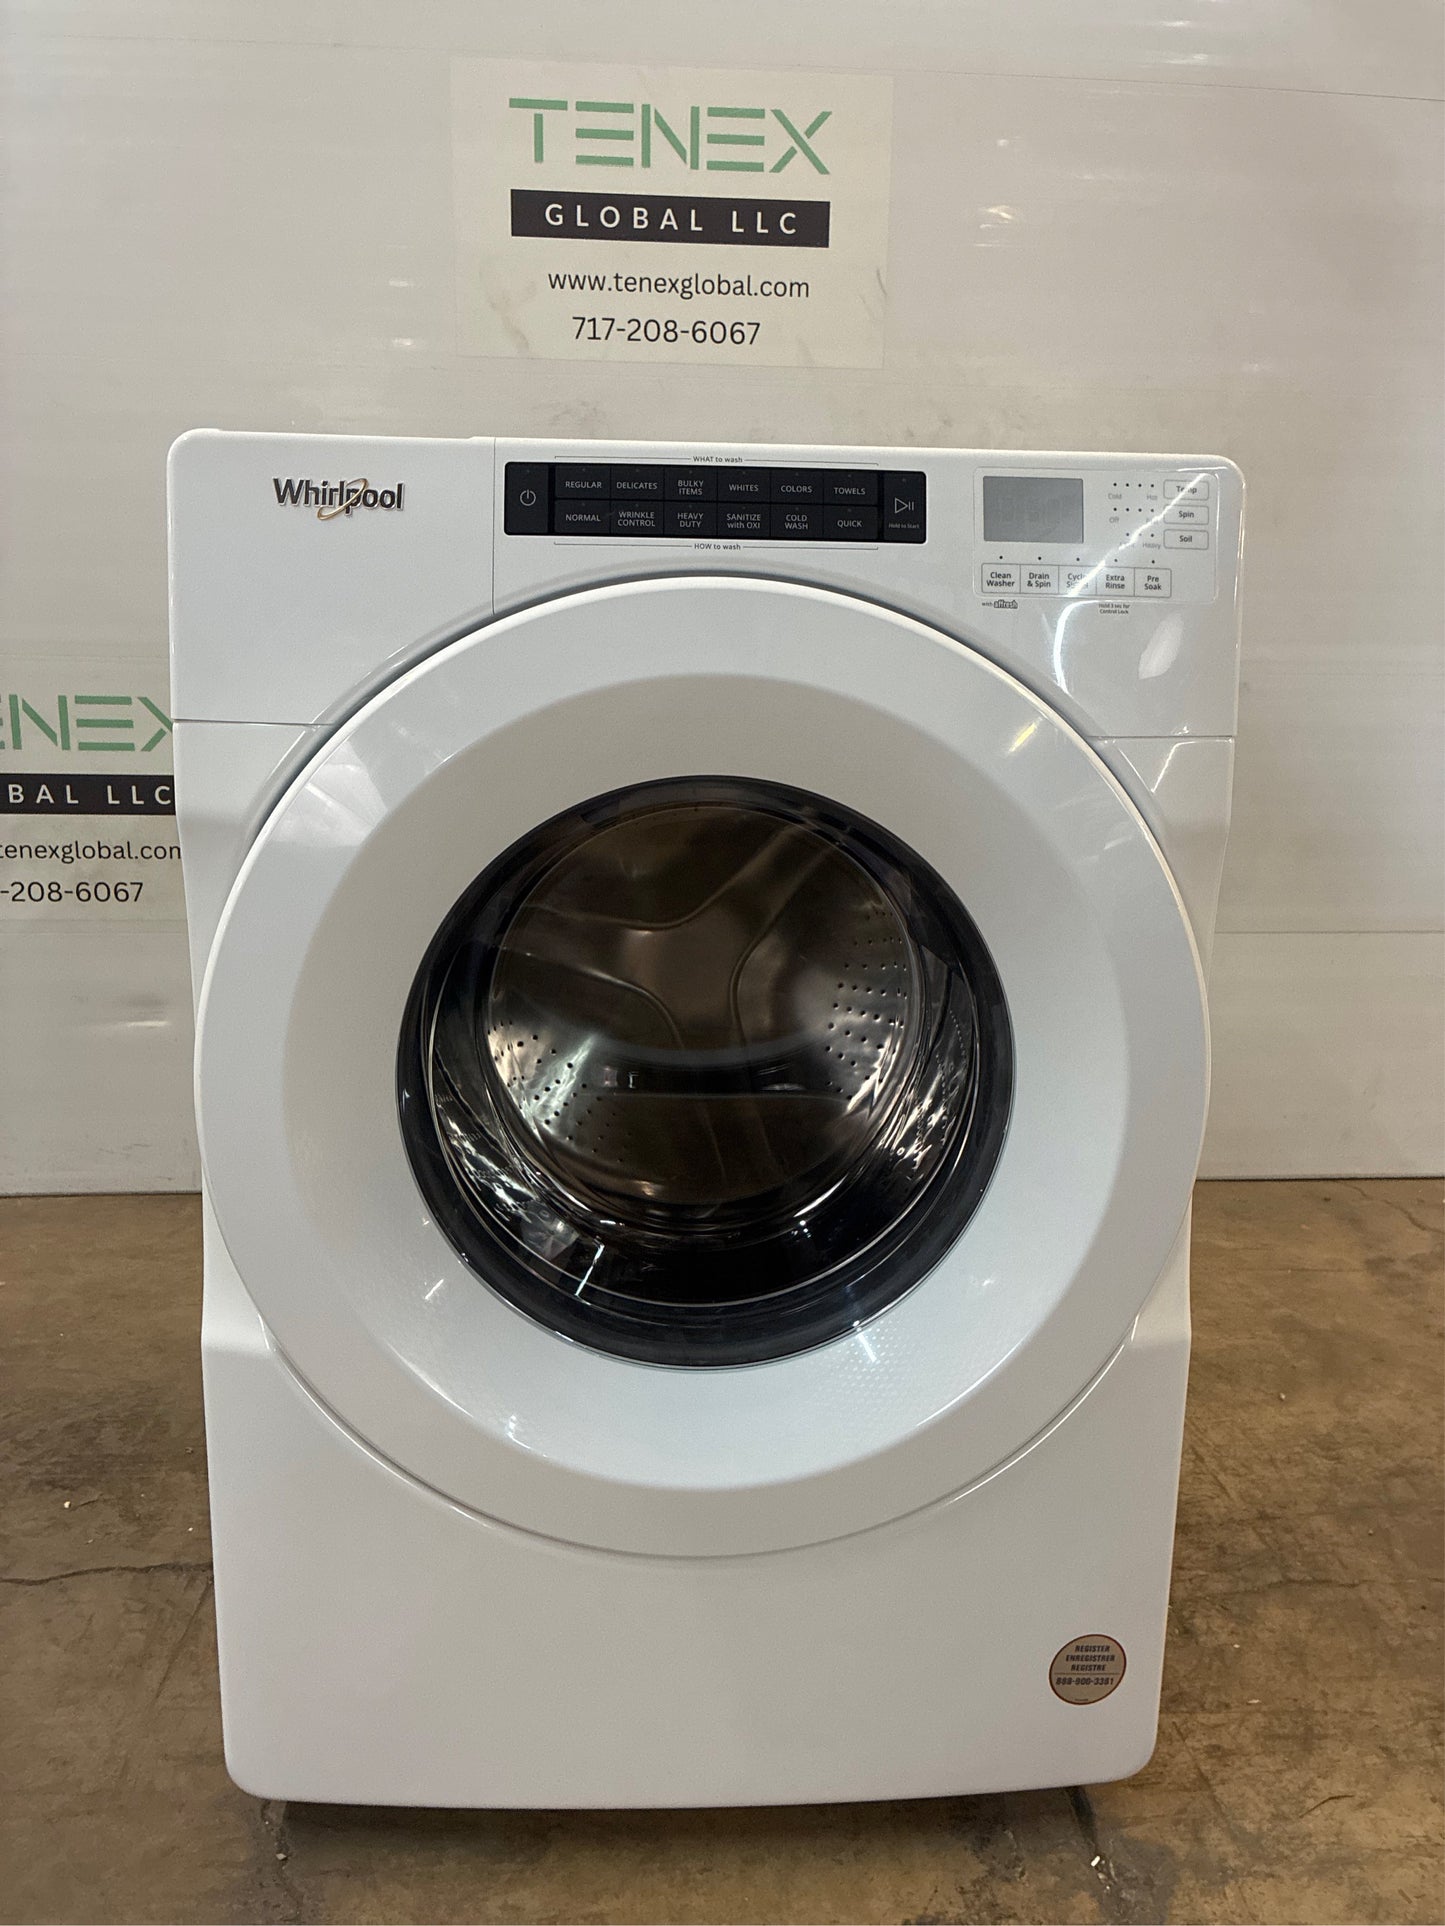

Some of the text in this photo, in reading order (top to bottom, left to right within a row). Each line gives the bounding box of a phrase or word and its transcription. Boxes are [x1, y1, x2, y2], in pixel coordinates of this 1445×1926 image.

[509, 98, 832, 175] TENEX
[545, 203, 797, 235] GLOBAL LLC
[548, 272, 810, 299] www.tenexglobal.com
[572, 316, 760, 345] 717-208-6067
[725, 456, 743, 464] wash
[565, 481, 602, 489] REGULAR
[616, 481, 658, 490] DELICATES
[729, 484, 759, 492] WHITES
[780, 485, 812, 493] COLORS
[679, 488, 703, 496] ITEMS
[834, 487, 866, 495] TOWELS
[273, 478, 404, 515] Whirlpool
[565, 514, 601, 522] NORMAL
[618, 511, 654, 519] WRINKLE
[677, 512, 704, 520] HEAVY
[726, 513, 761, 521] SANITIZE
[785, 514, 808, 522] COLD
[1178, 511, 1195, 519] Spin
[617, 519, 655, 527] CONTROL
[679, 520, 702, 528] DUTY
[727, 521, 744, 529] with
[784, 522, 808, 530] WASH
[837, 519, 862, 528] QUICK
[1179, 535, 1193, 543] Soil
[990, 571, 1012, 579] Clean
[1028, 572, 1050, 580] Drain
[1105, 574, 1125, 582] Extra
[1147, 575, 1159, 583] Pre
[986, 579, 1015, 587] Washer
[1027, 580, 1051, 589] & Spin
[1105, 581, 1125, 590] Rinse
[1144, 582, 1162, 591] Soak
[8, 784, 171, 805] BAL LLC
[1066, 1654, 1116, 1662] ENREGISTRER
